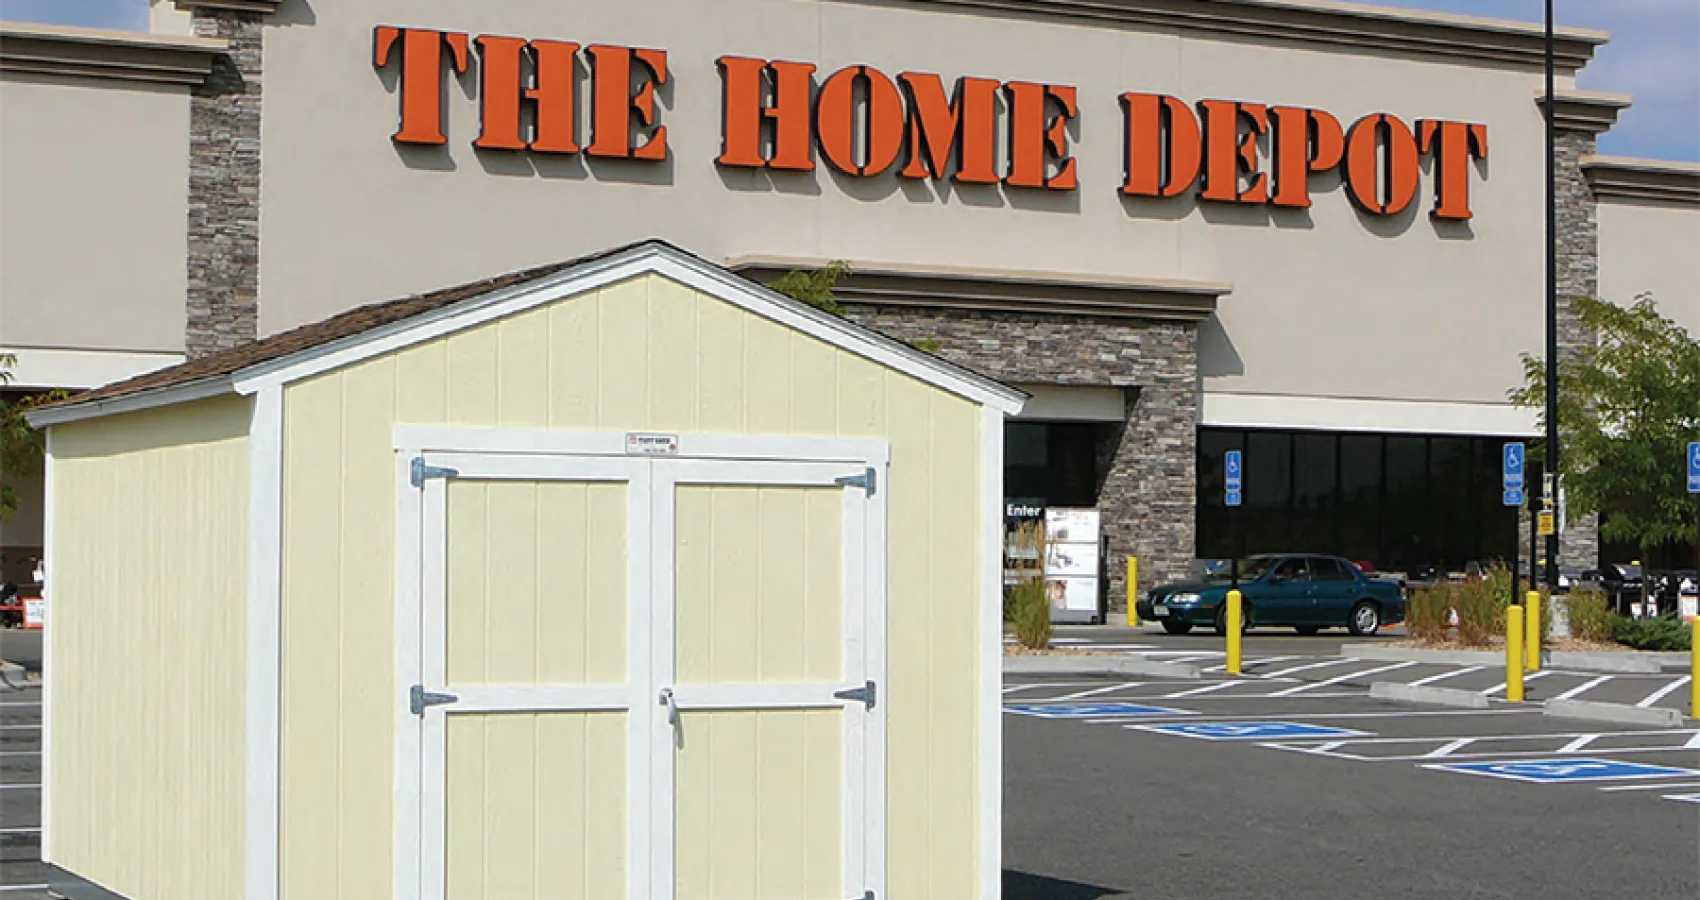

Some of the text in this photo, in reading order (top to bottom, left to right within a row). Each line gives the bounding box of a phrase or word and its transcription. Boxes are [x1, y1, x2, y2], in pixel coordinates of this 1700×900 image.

[374, 26, 1488, 219] THE HOME DEPOT
[1006, 503, 1041, 517] Enter
